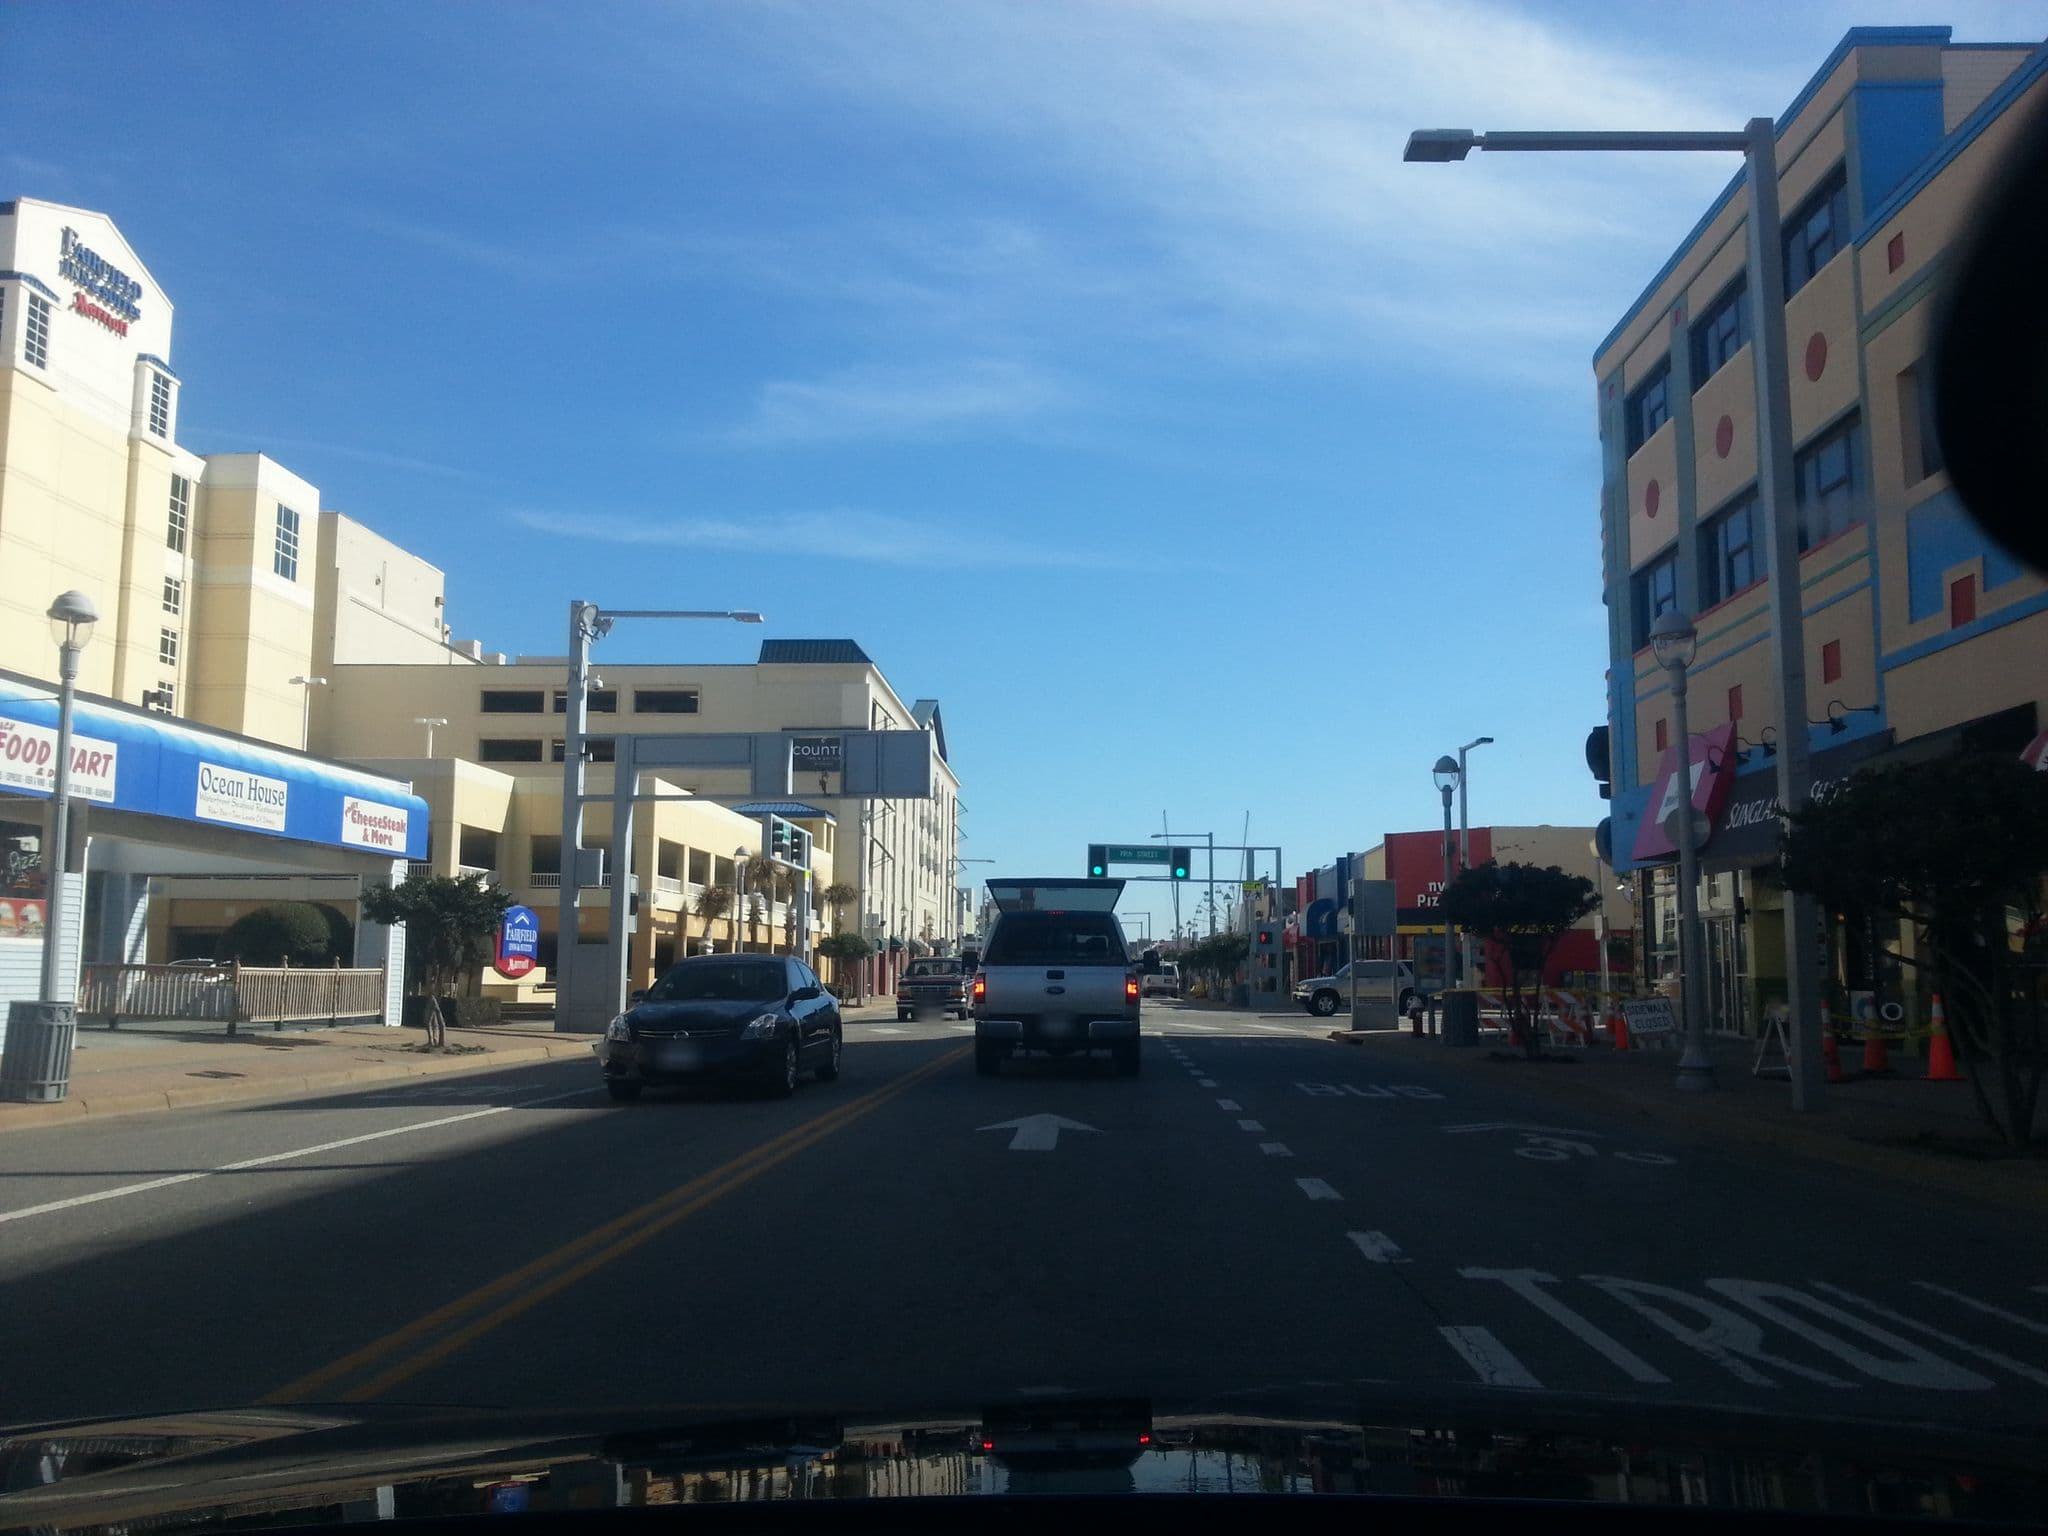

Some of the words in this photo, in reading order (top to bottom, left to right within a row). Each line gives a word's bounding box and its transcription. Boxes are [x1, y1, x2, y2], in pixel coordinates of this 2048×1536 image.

[200, 767, 244, 799] Ocean
[247, 777, 285, 807] House
[371, 829, 393, 846] More
[506, 923, 537, 943] FAIRFIELD
